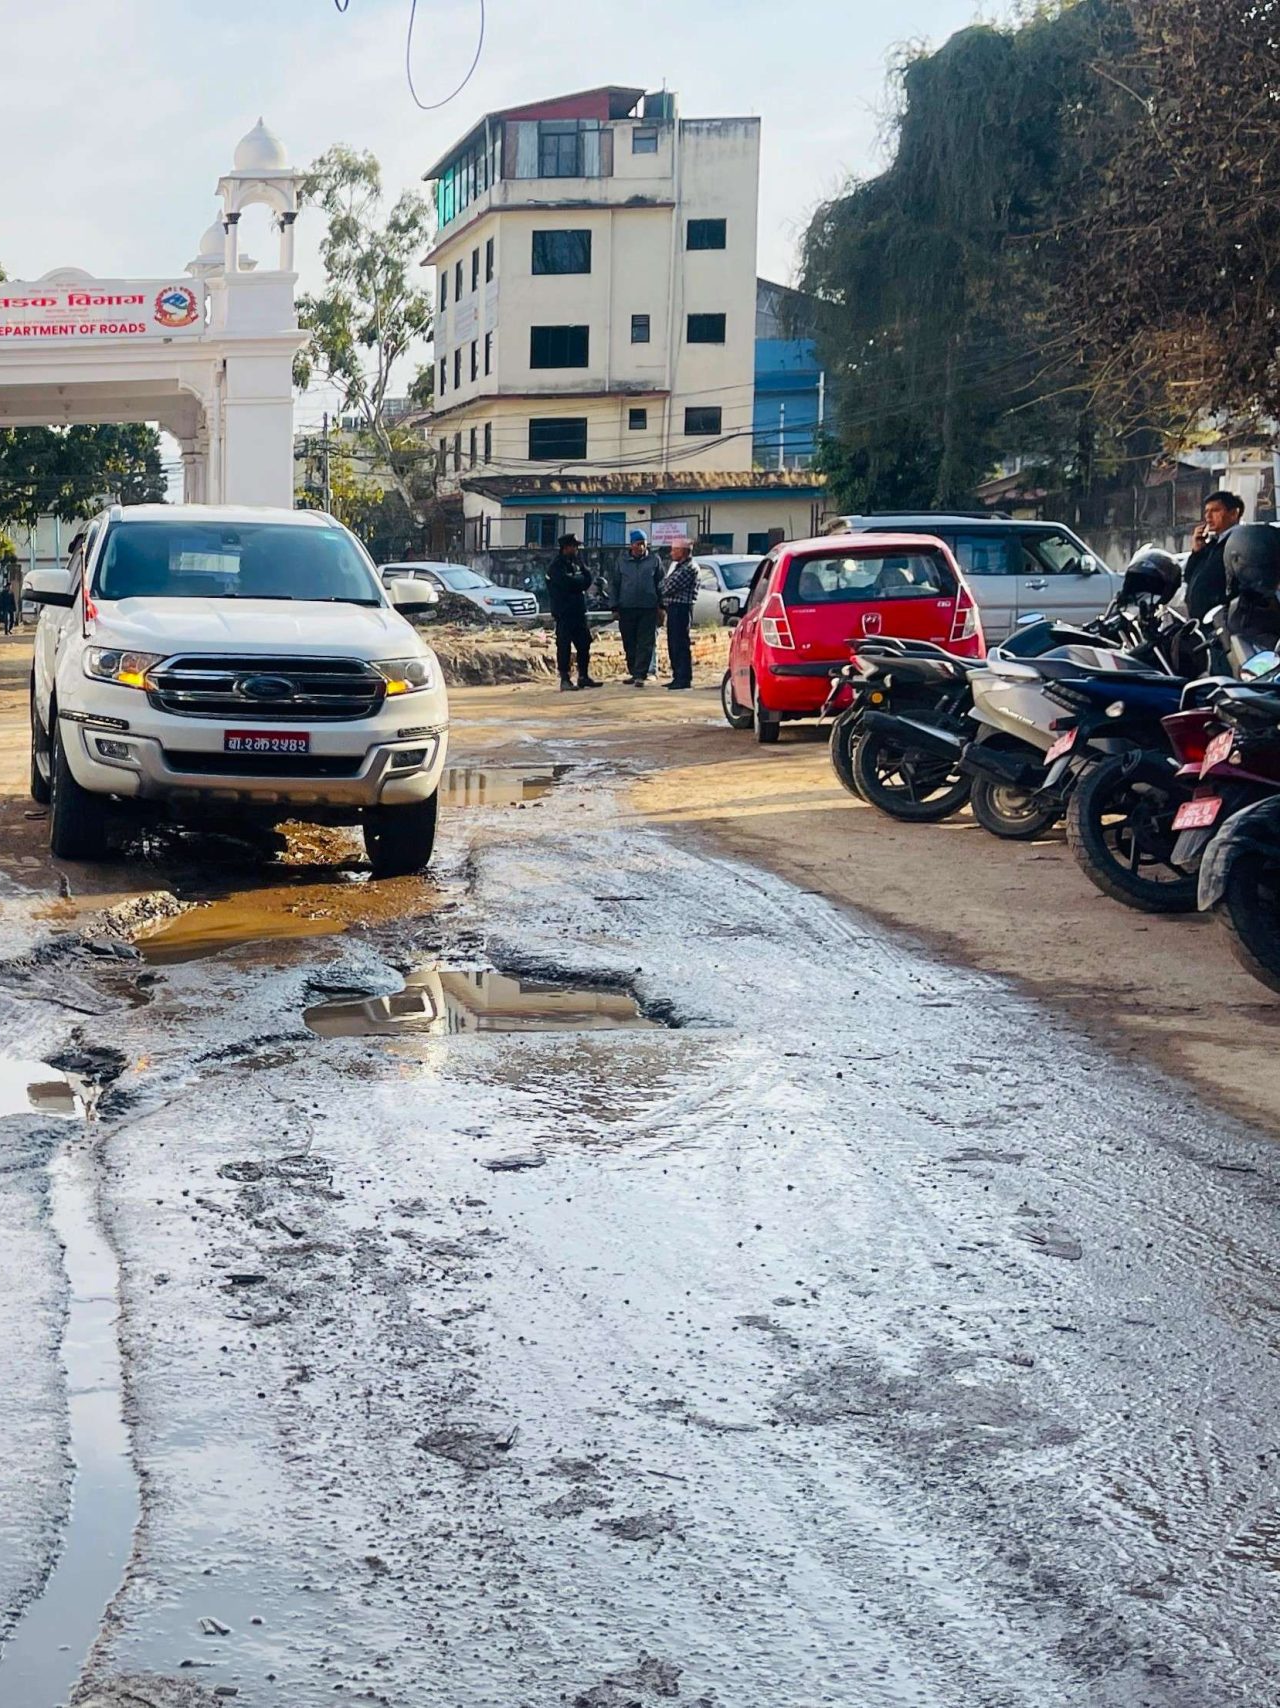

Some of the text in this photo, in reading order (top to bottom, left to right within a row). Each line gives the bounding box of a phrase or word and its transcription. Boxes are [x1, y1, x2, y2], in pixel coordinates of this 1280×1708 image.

[68, 293, 146, 305] विभाग
[80, 324, 96, 334] OF
[100, 323, 146, 334] ROADS
